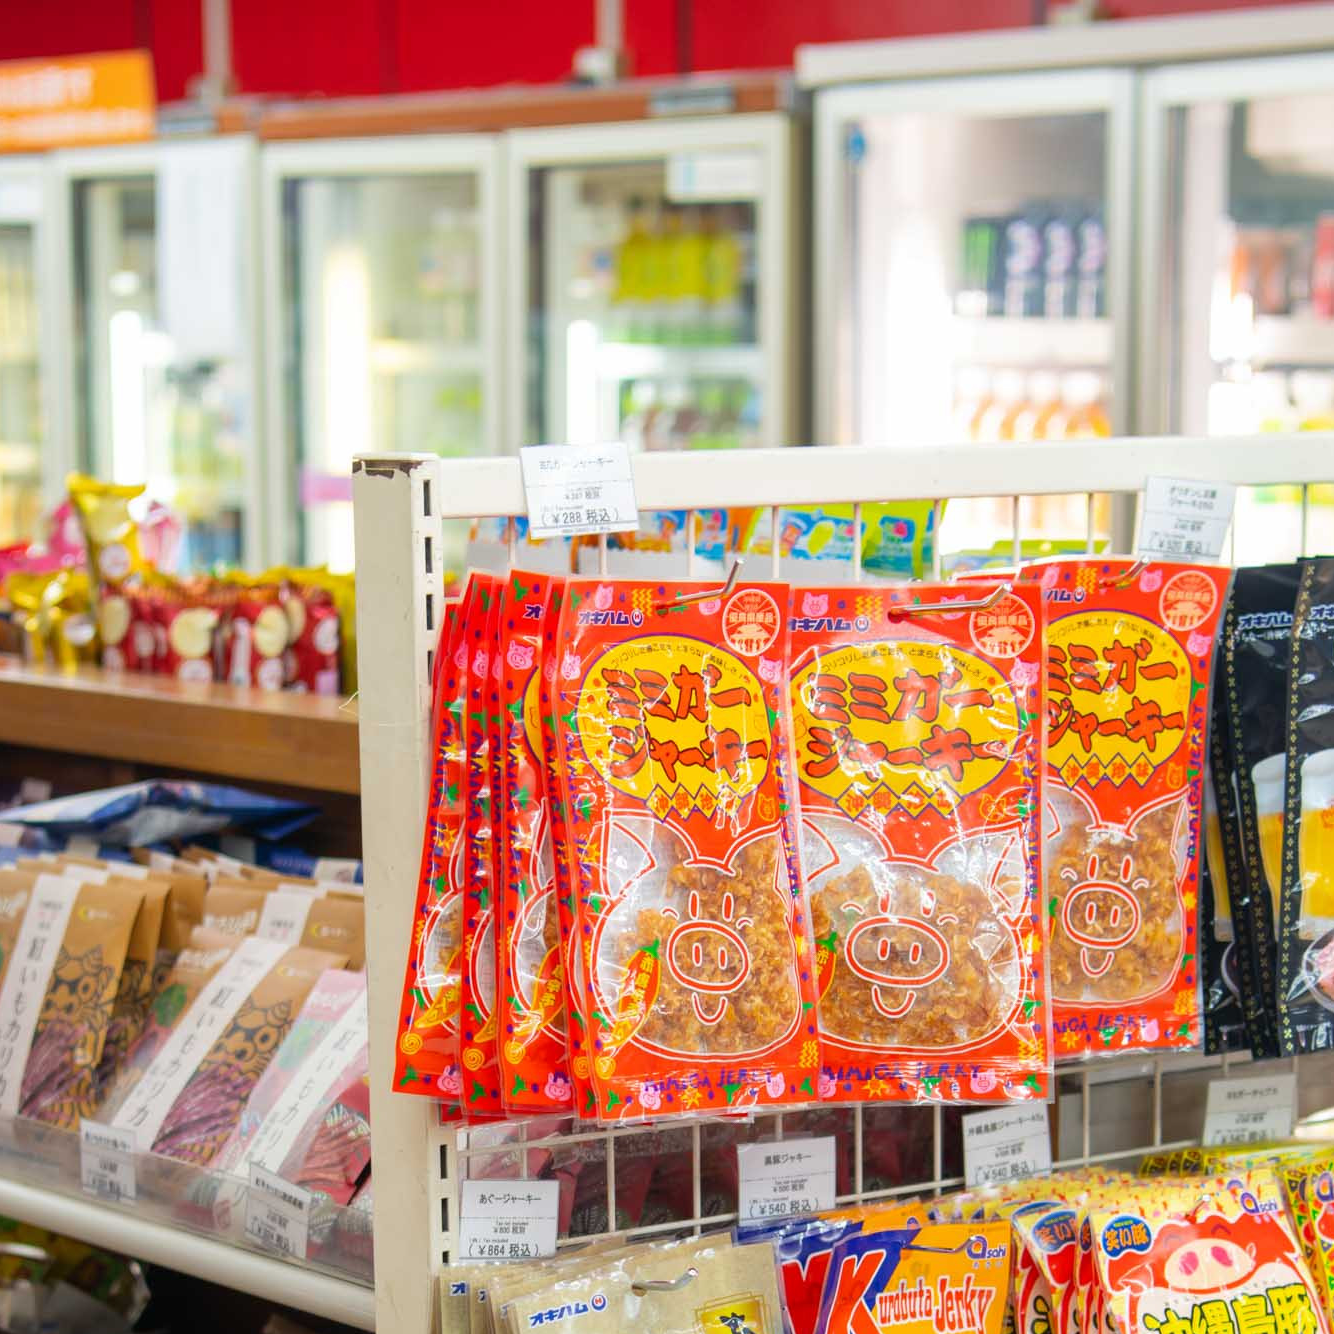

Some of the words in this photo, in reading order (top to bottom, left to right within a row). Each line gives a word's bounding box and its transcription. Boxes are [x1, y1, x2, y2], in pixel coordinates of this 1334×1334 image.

[587, 509, 611, 524] 税込
[577, 611, 630, 626] オキハム
[1238, 612, 1292, 628] オキハム
[1047, 638, 1178, 696] ミミガー
[601, 664, 752, 723] ミミガー
[808, 669, 995, 724] ミミガー
[1047, 696, 1184, 753] ジャーキー
[608, 724, 768, 783] ジャーキー
[805, 725, 1008, 782] ジャーキー
[479, 1193, 542, 1205] あぐージャーキー
[759, 1202, 787, 1215] ¥540
[790, 1200, 812, 1215] 税込
[478, 1244, 505, 1256] ¥864
[509, 1243, 531, 1258] 税込
[529, 1301, 590, 1328] オキハム
